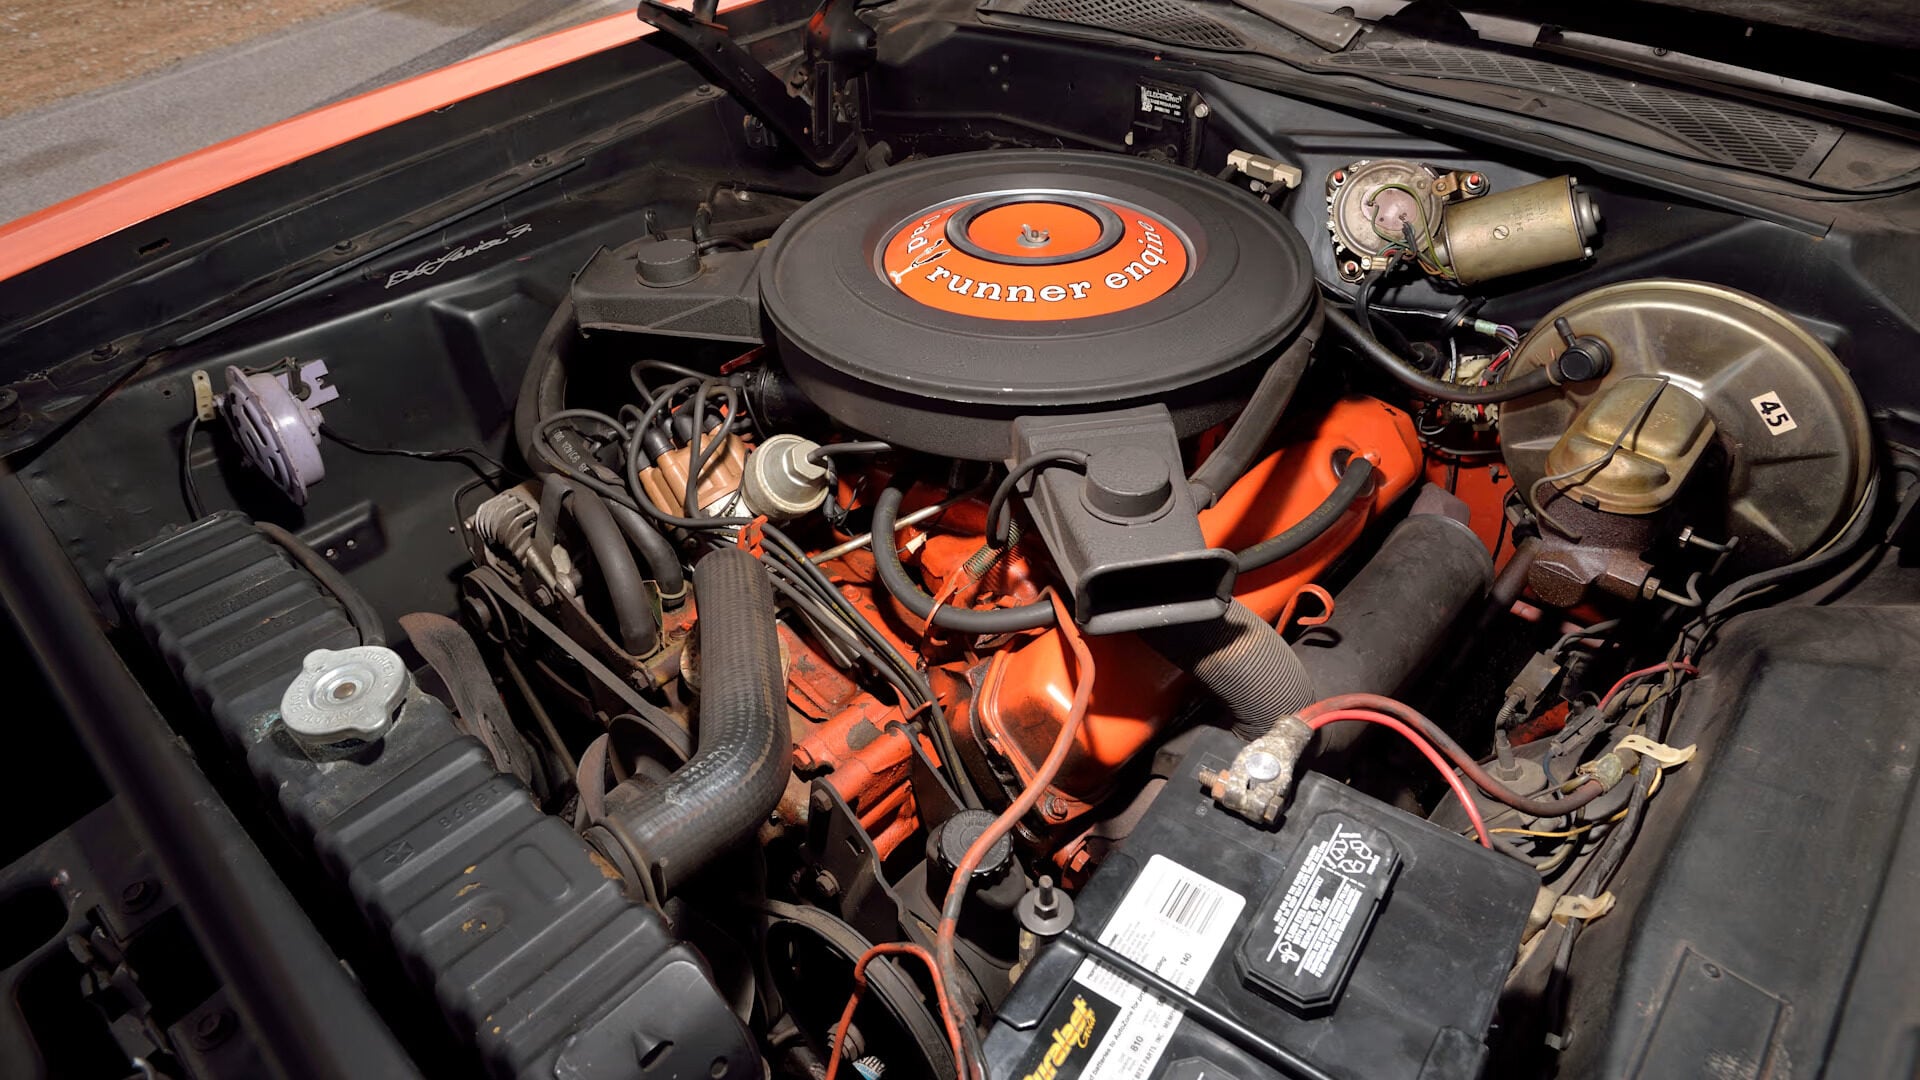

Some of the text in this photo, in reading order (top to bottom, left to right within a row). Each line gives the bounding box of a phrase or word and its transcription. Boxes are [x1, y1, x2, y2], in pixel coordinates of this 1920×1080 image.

[925, 265, 1091, 303] runner
[1104, 218, 1169, 290] engine
[1760, 401, 1789, 427] 45
[1179, 952, 1192, 967] 140
[1111, 1009, 1134, 1040] AutoZone
[1129, 1034, 1144, 1052] 810
